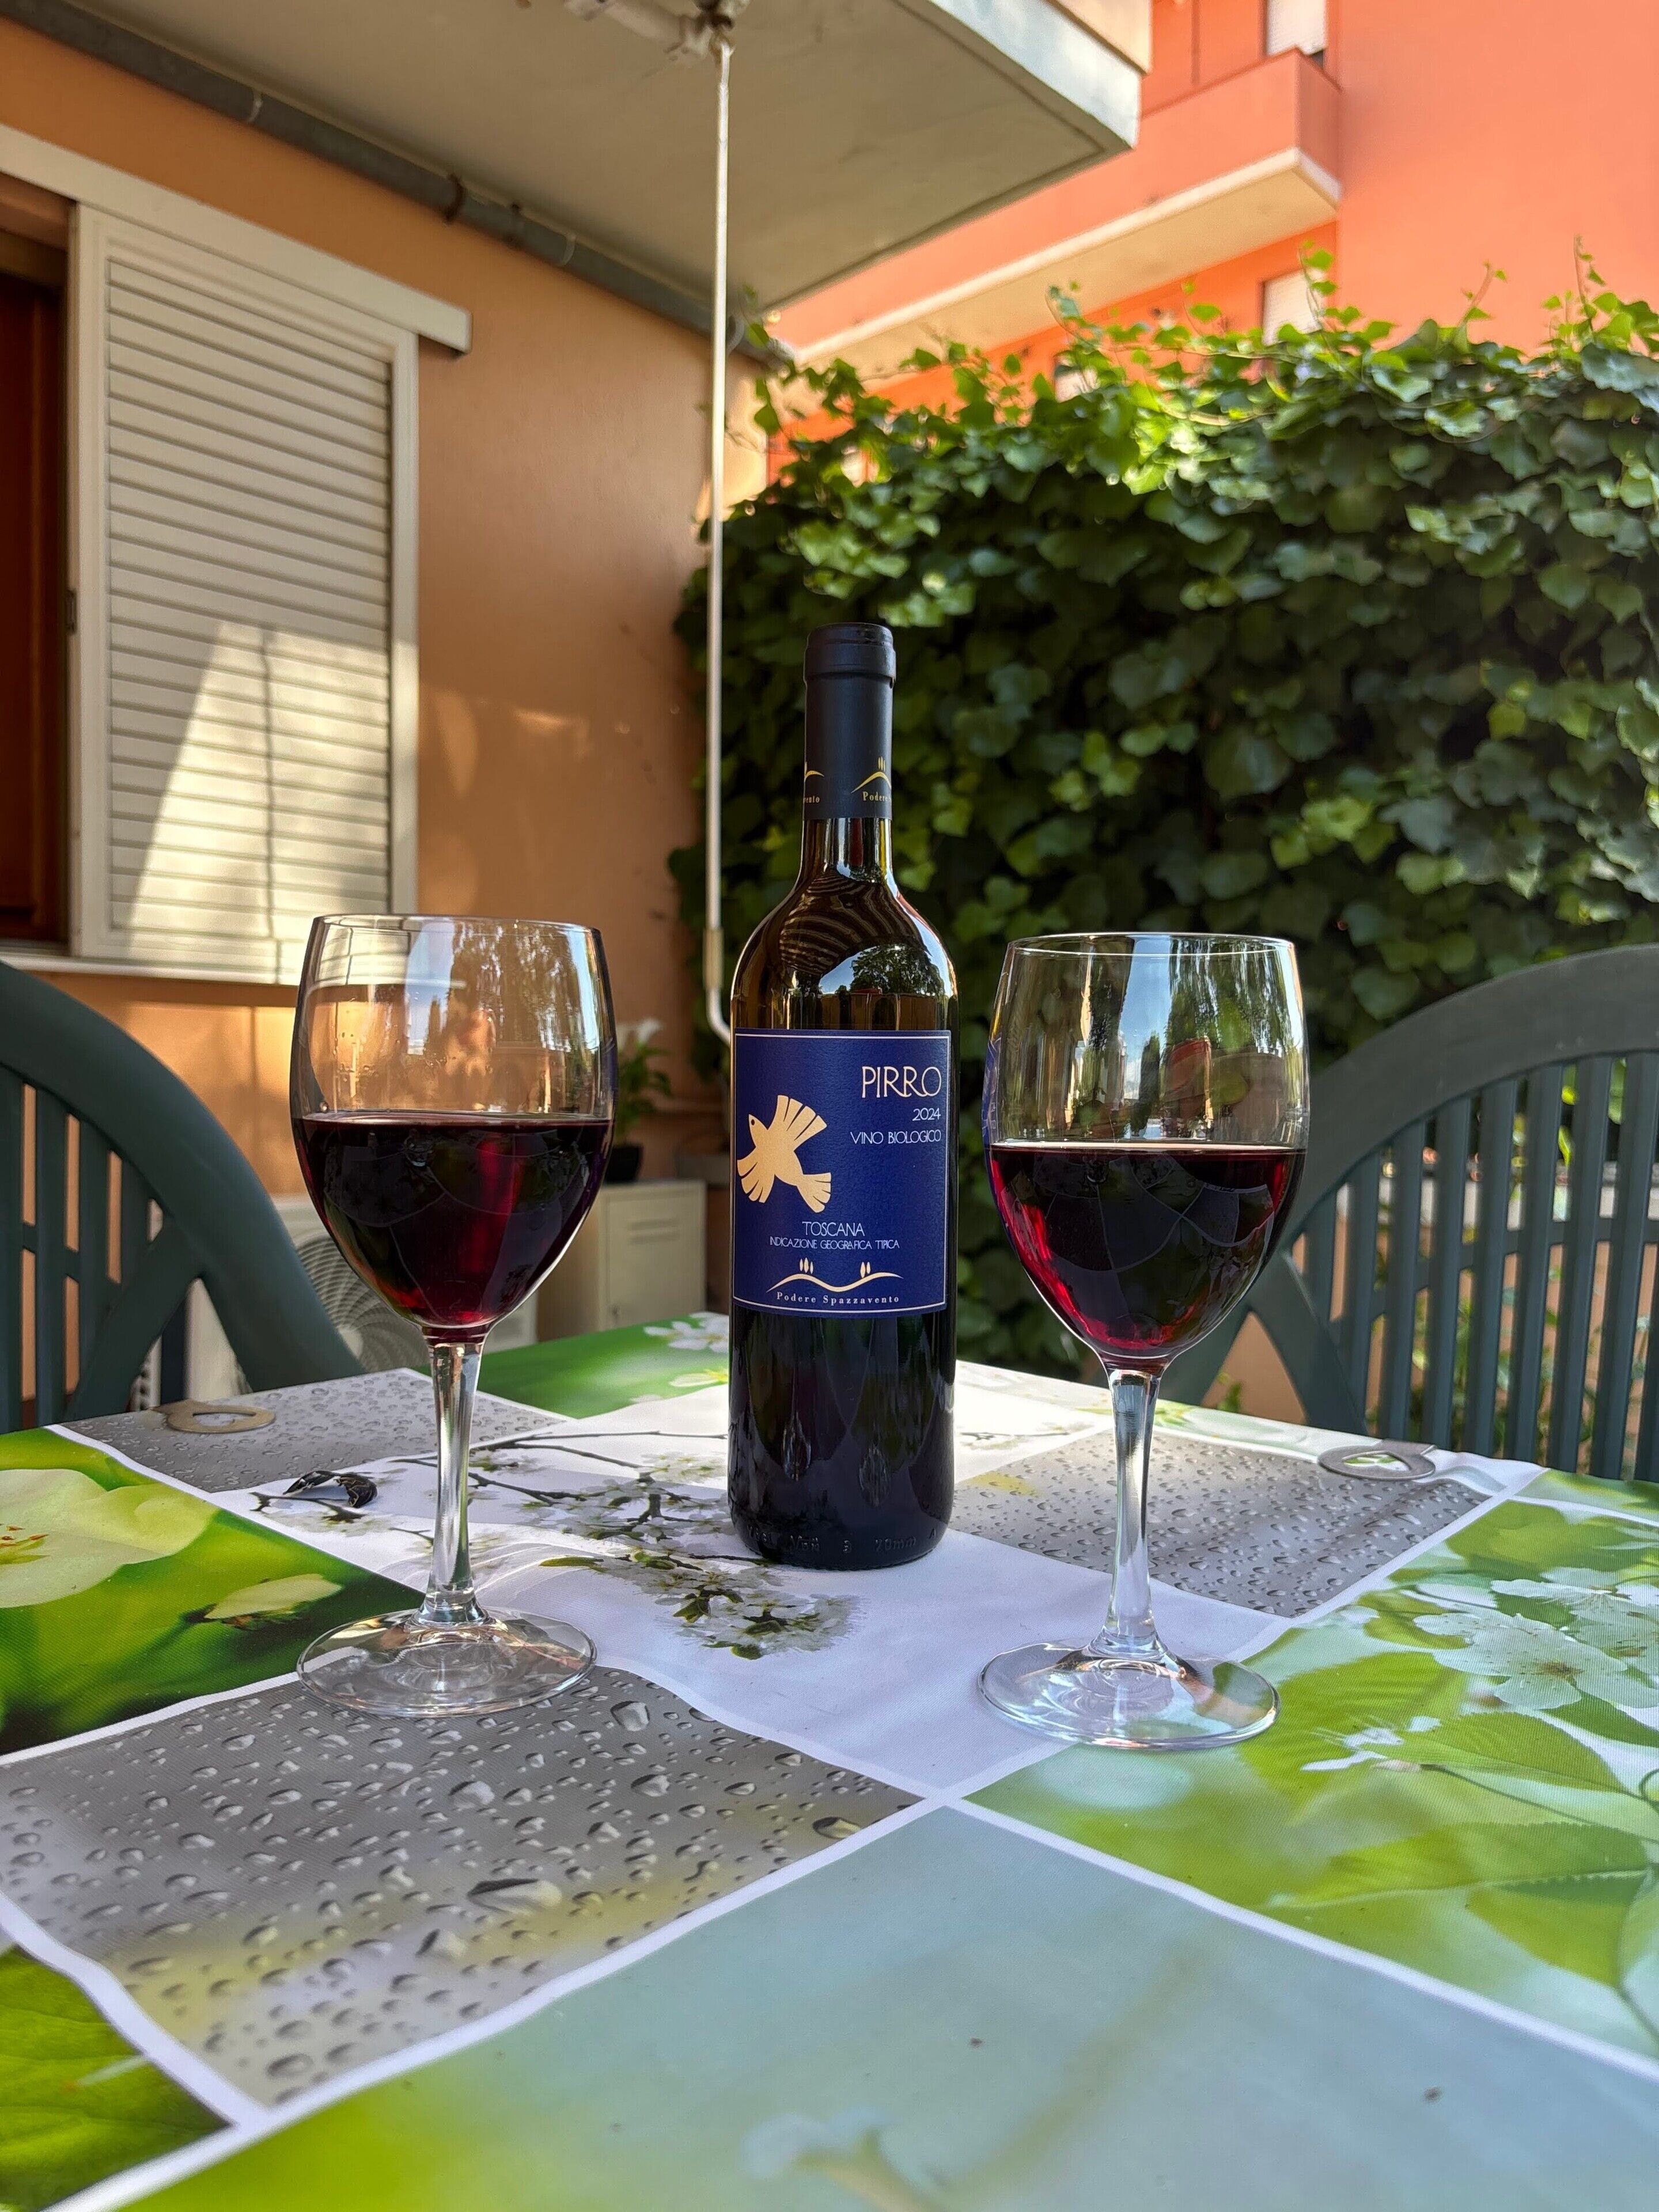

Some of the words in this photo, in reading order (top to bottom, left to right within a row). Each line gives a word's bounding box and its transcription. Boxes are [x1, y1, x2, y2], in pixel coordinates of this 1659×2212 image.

[862, 1066, 942, 1098] PIRRO
[912, 1107, 941, 1121] 2024
[850, 1131, 884, 1144] VINO
[888, 1129, 941, 1145] BIOLOGICO
[802, 1221, 865, 1237] TOSCANA
[820, 1239, 872, 1250] GEOGRAFICA
[875, 1239, 900, 1249] TIPICA
[777, 1291, 817, 1303] Podere
[823, 1294, 900, 1306] Spazzavento
